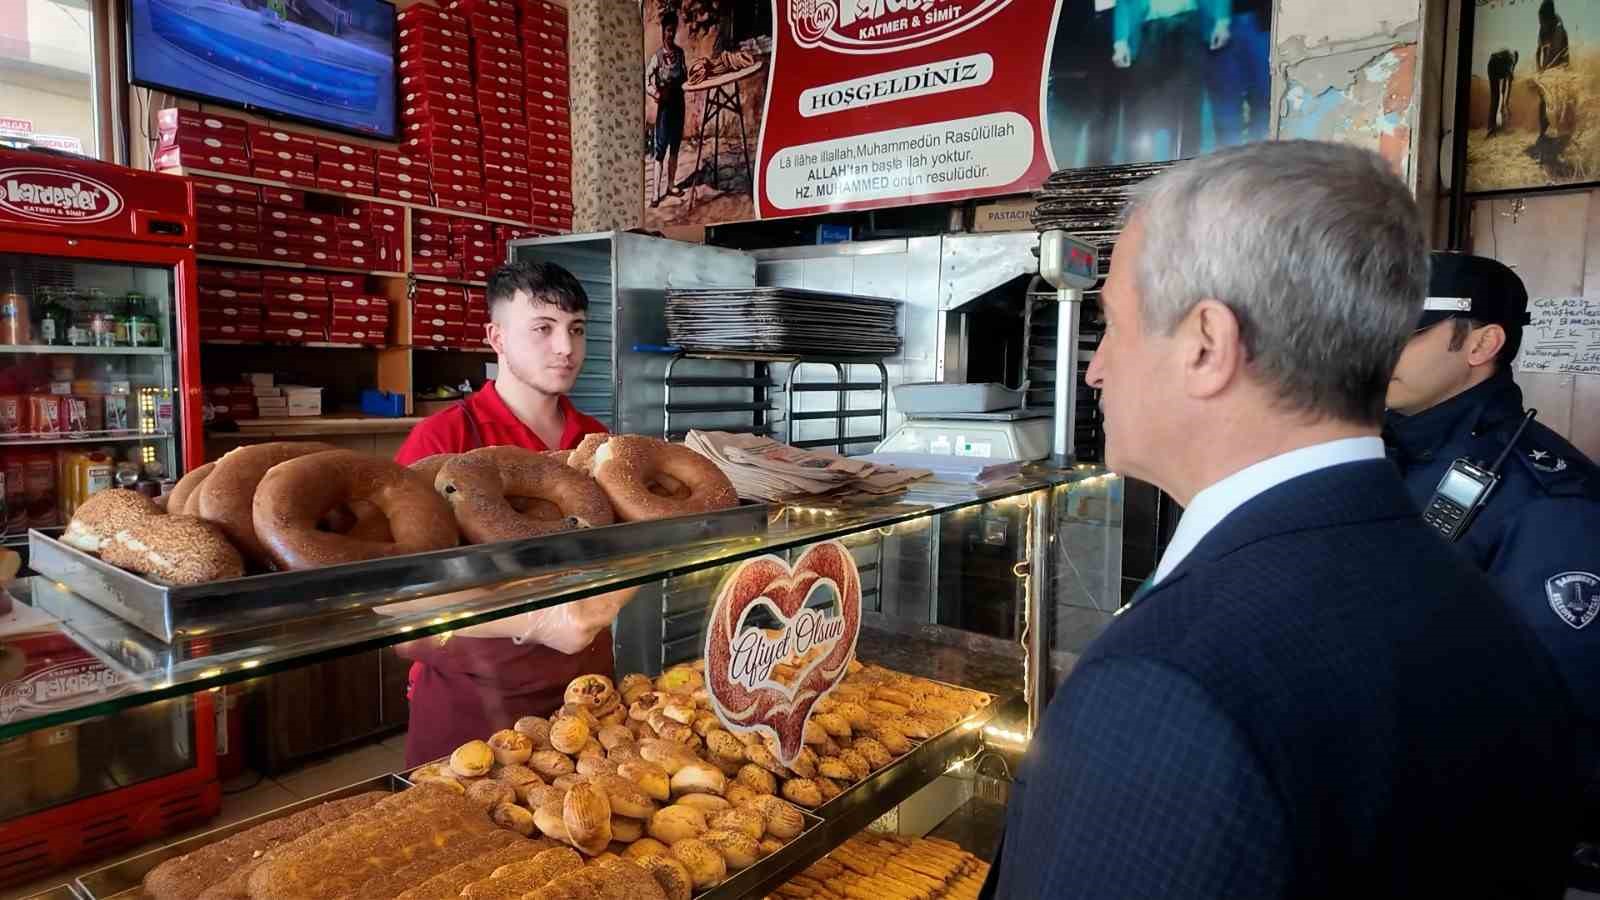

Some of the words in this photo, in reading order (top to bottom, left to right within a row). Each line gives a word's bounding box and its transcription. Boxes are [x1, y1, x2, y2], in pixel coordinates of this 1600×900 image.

[816, 7, 832, 23] AK
[859, 20, 908, 40] KATMER
[911, 15, 921, 27] &
[925, 5, 962, 24] SİMİT
[811, 61, 978, 110] HOŞGELDİNİZ
[931, 149, 975, 169] yoktur.
[795, 188, 814, 200] HZ.
[816, 178, 890, 198] MUHAMMED
[926, 167, 990, 185] resulüdür.
[731, 628, 791, 687] Afiyet
[795, 612, 843, 652] Olsun
